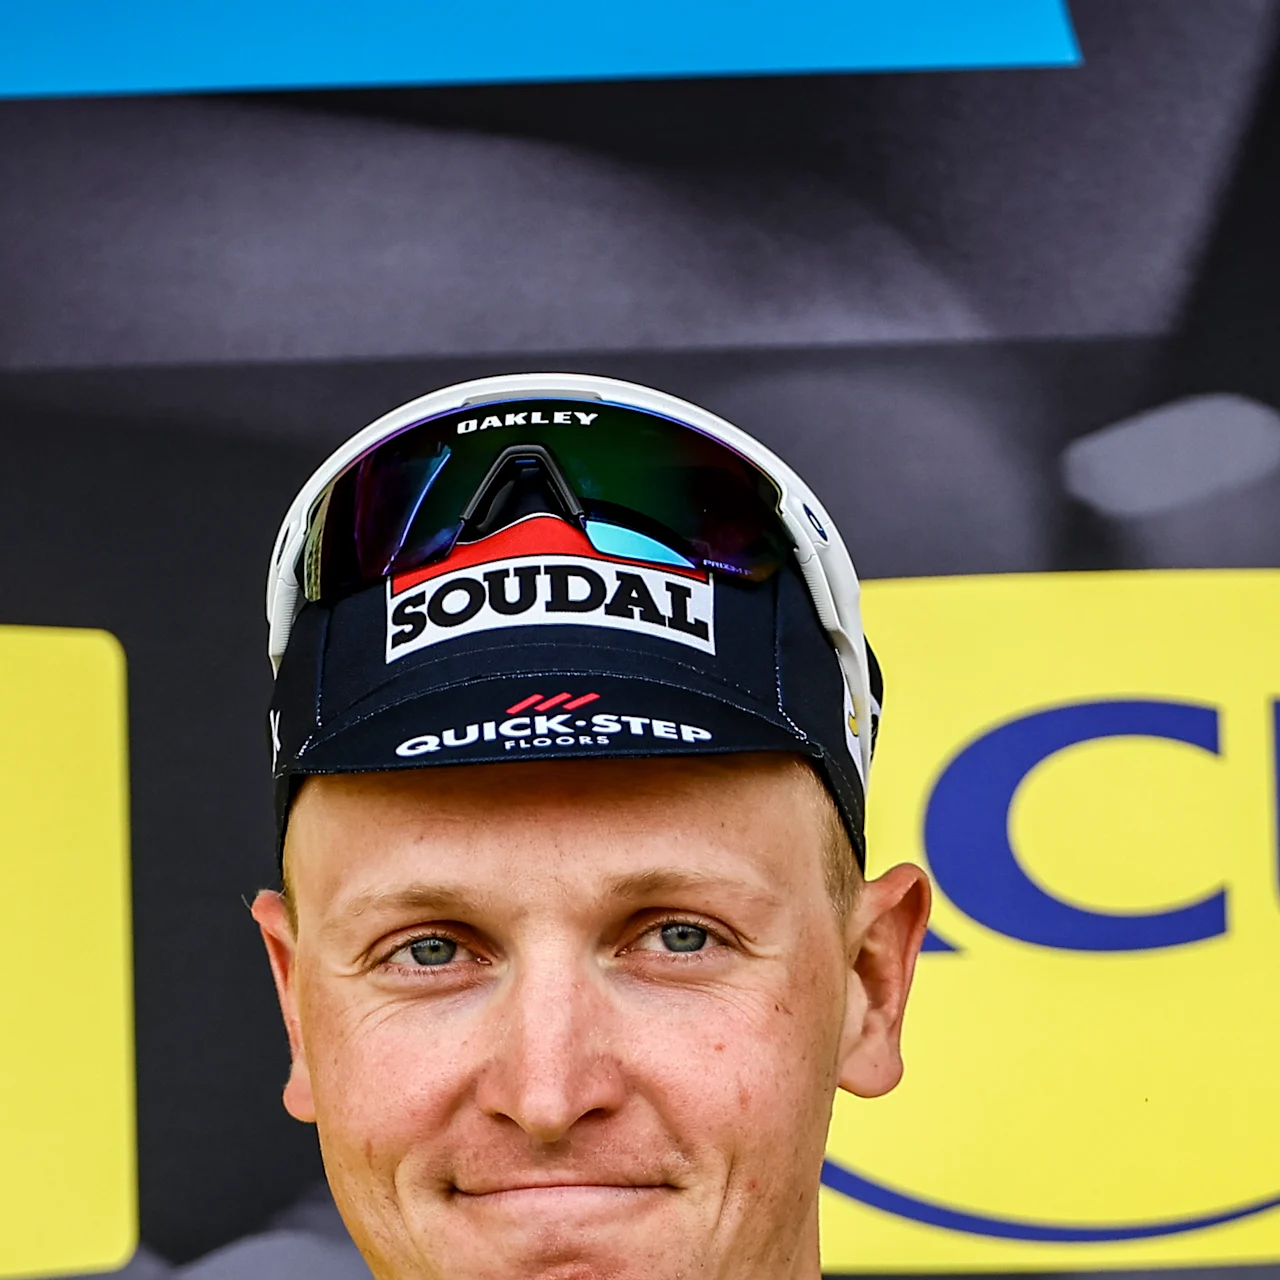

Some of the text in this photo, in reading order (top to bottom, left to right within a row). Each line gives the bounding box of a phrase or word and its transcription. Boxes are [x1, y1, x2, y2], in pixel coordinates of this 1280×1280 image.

[457, 410, 599, 435] OAKLEY
[391, 564, 711, 650] SOUDAL
[504, 735, 610, 751] FLOORS
